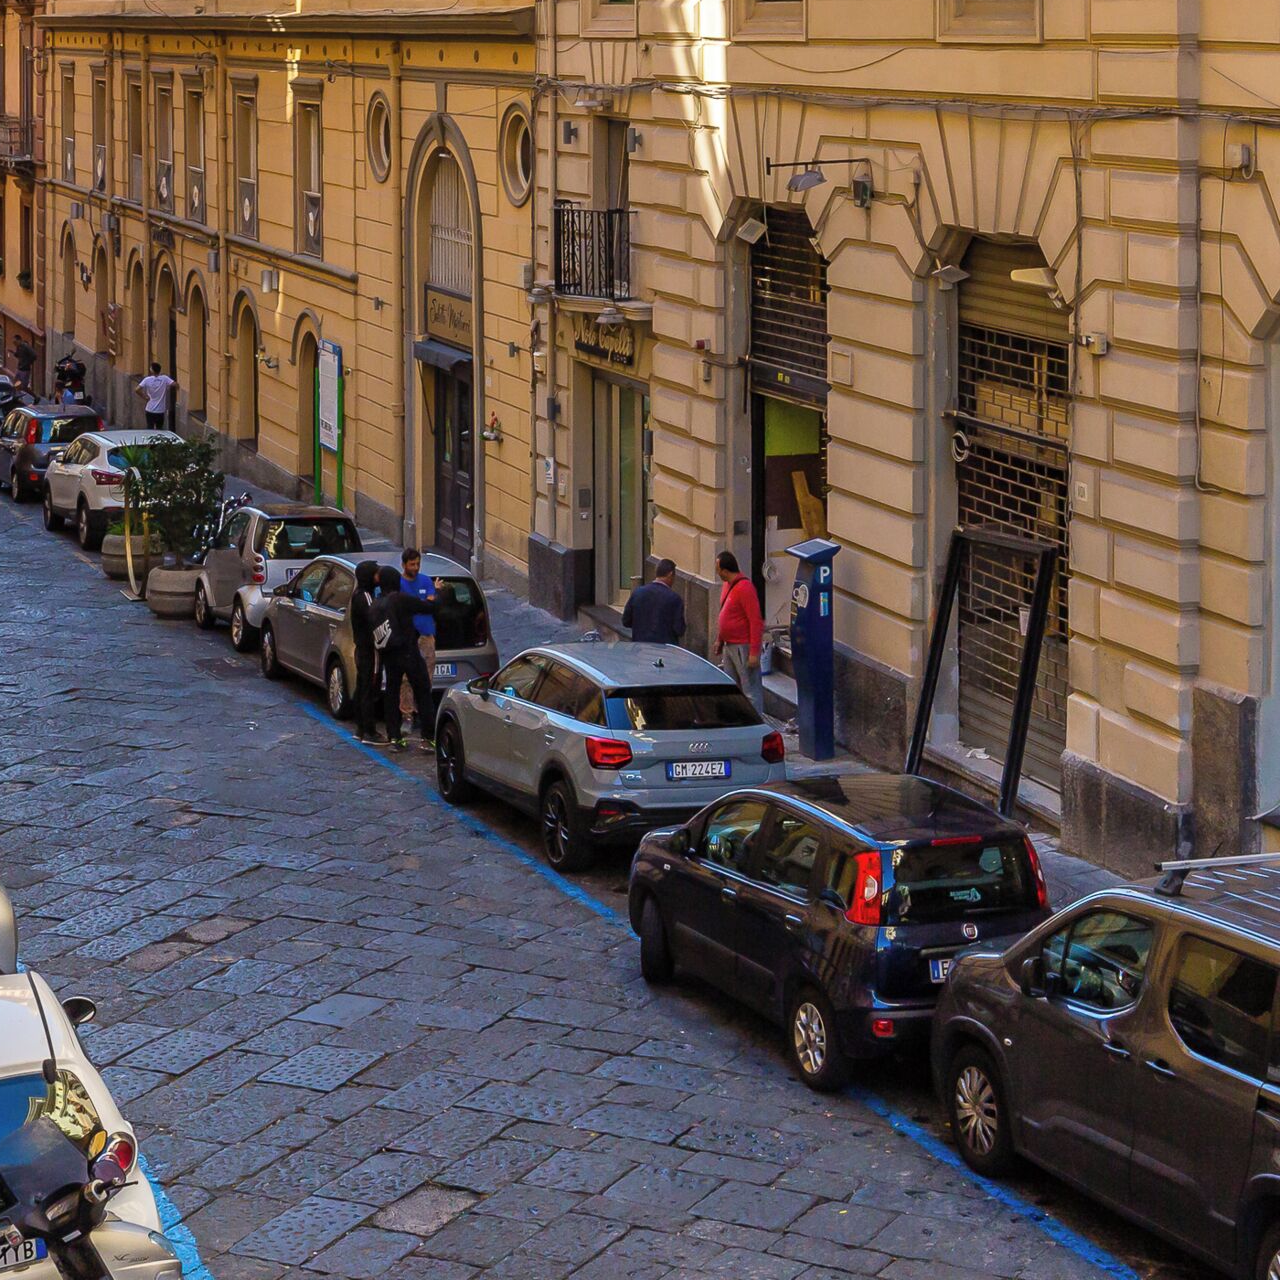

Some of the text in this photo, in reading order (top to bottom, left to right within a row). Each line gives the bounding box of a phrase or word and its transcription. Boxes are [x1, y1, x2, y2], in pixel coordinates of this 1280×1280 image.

[820, 566, 830, 583] P
[373, 619, 390, 642] NIKE
[691, 762, 725, 776] 224EZ
